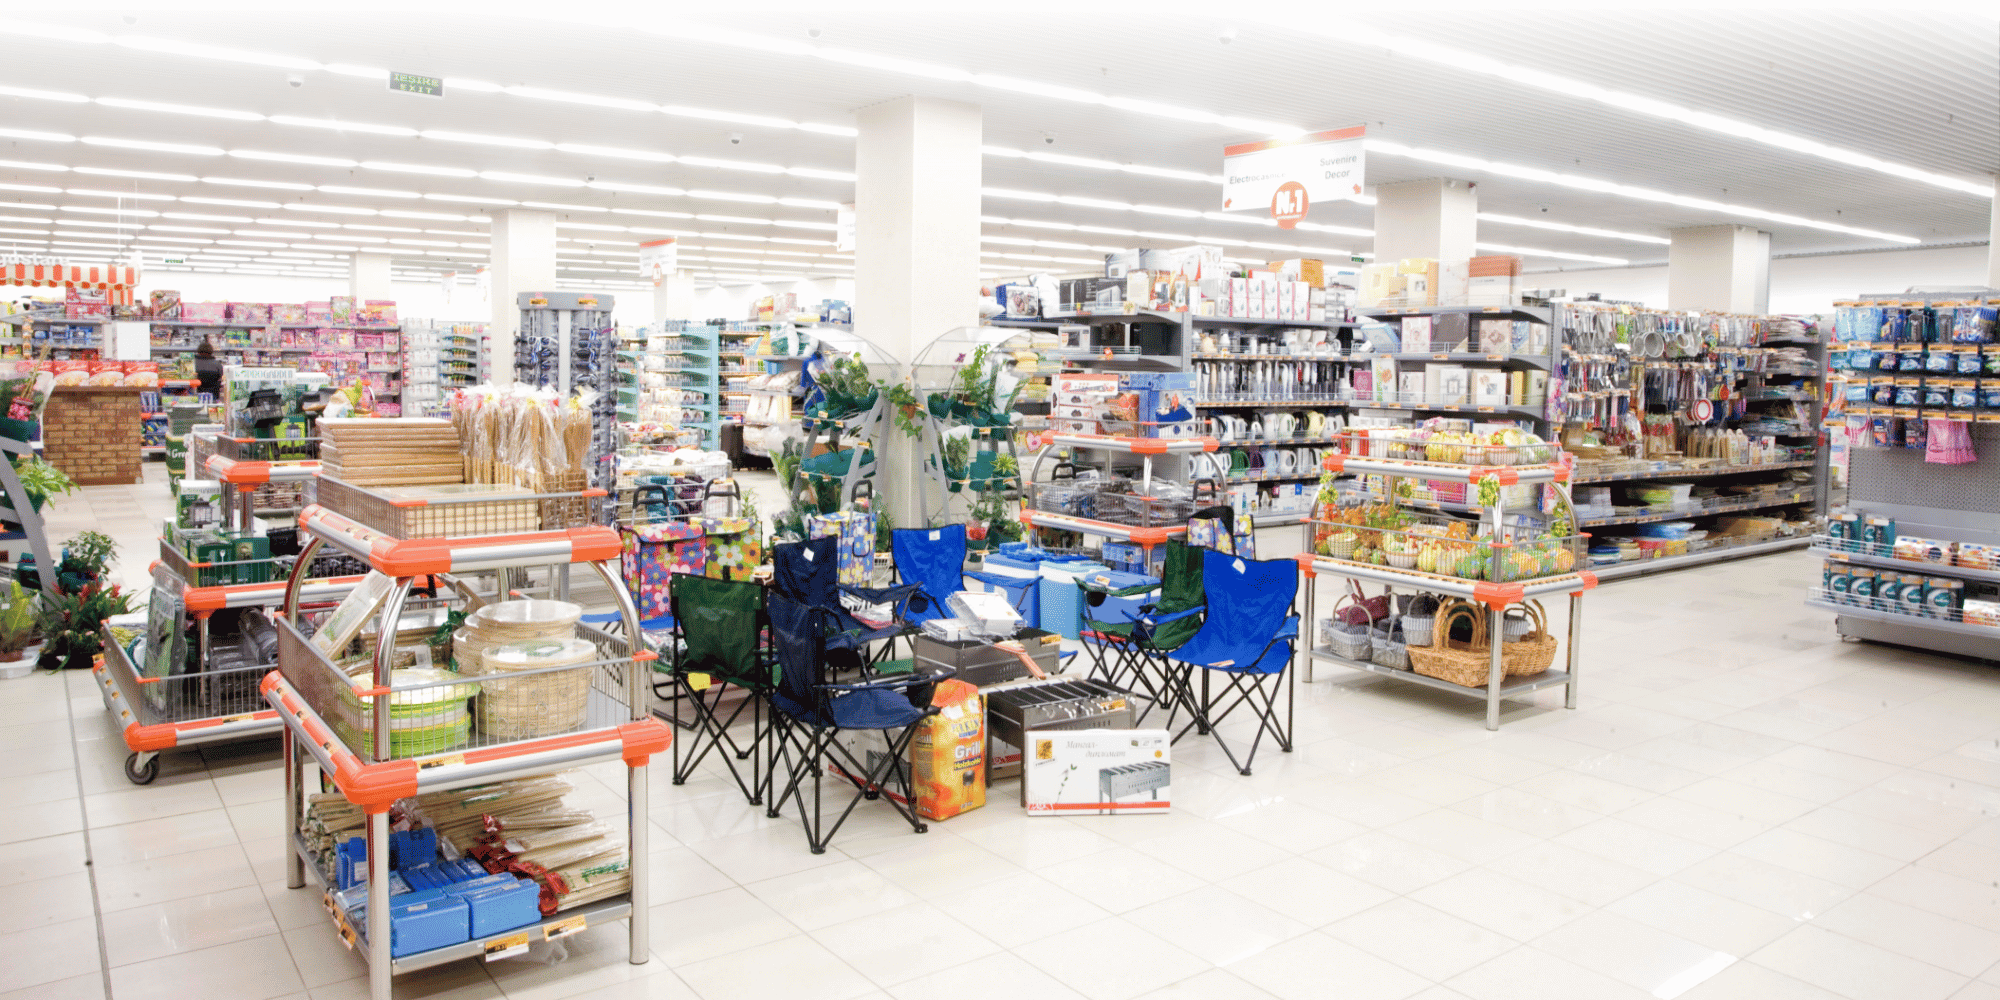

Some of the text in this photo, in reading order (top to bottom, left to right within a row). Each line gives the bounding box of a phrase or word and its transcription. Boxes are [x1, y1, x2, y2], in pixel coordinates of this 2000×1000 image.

[400, 83, 433, 94] EXIT
[1320, 154, 1357, 167] Suvenire
[1325, 169, 1351, 180] Decor
[955, 740, 981, 759] Grill
